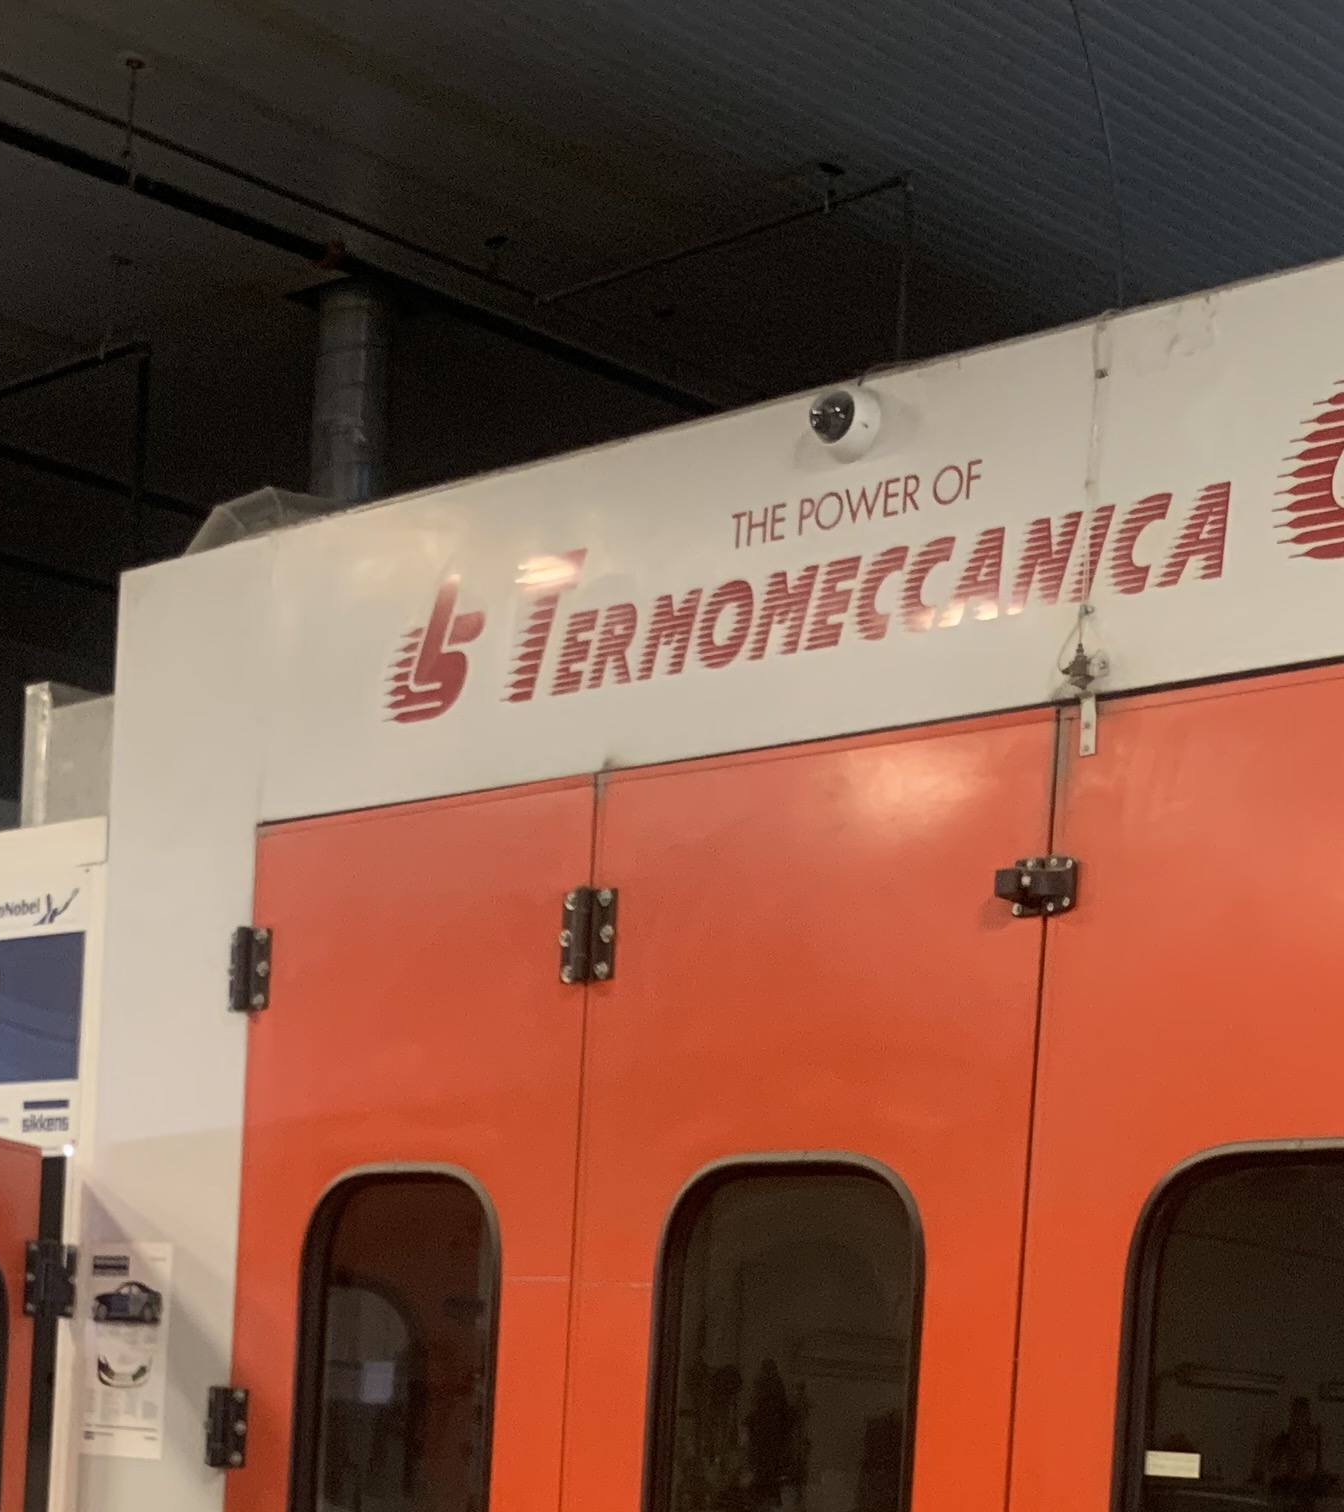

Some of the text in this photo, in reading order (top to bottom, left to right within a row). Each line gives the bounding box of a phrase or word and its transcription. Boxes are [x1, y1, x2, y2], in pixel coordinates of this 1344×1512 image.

[732, 459, 983, 549] THE POWER OF
[499, 481, 1231, 703] TERMOMECCANICA
[22, 1114, 69, 1132] sikkens
